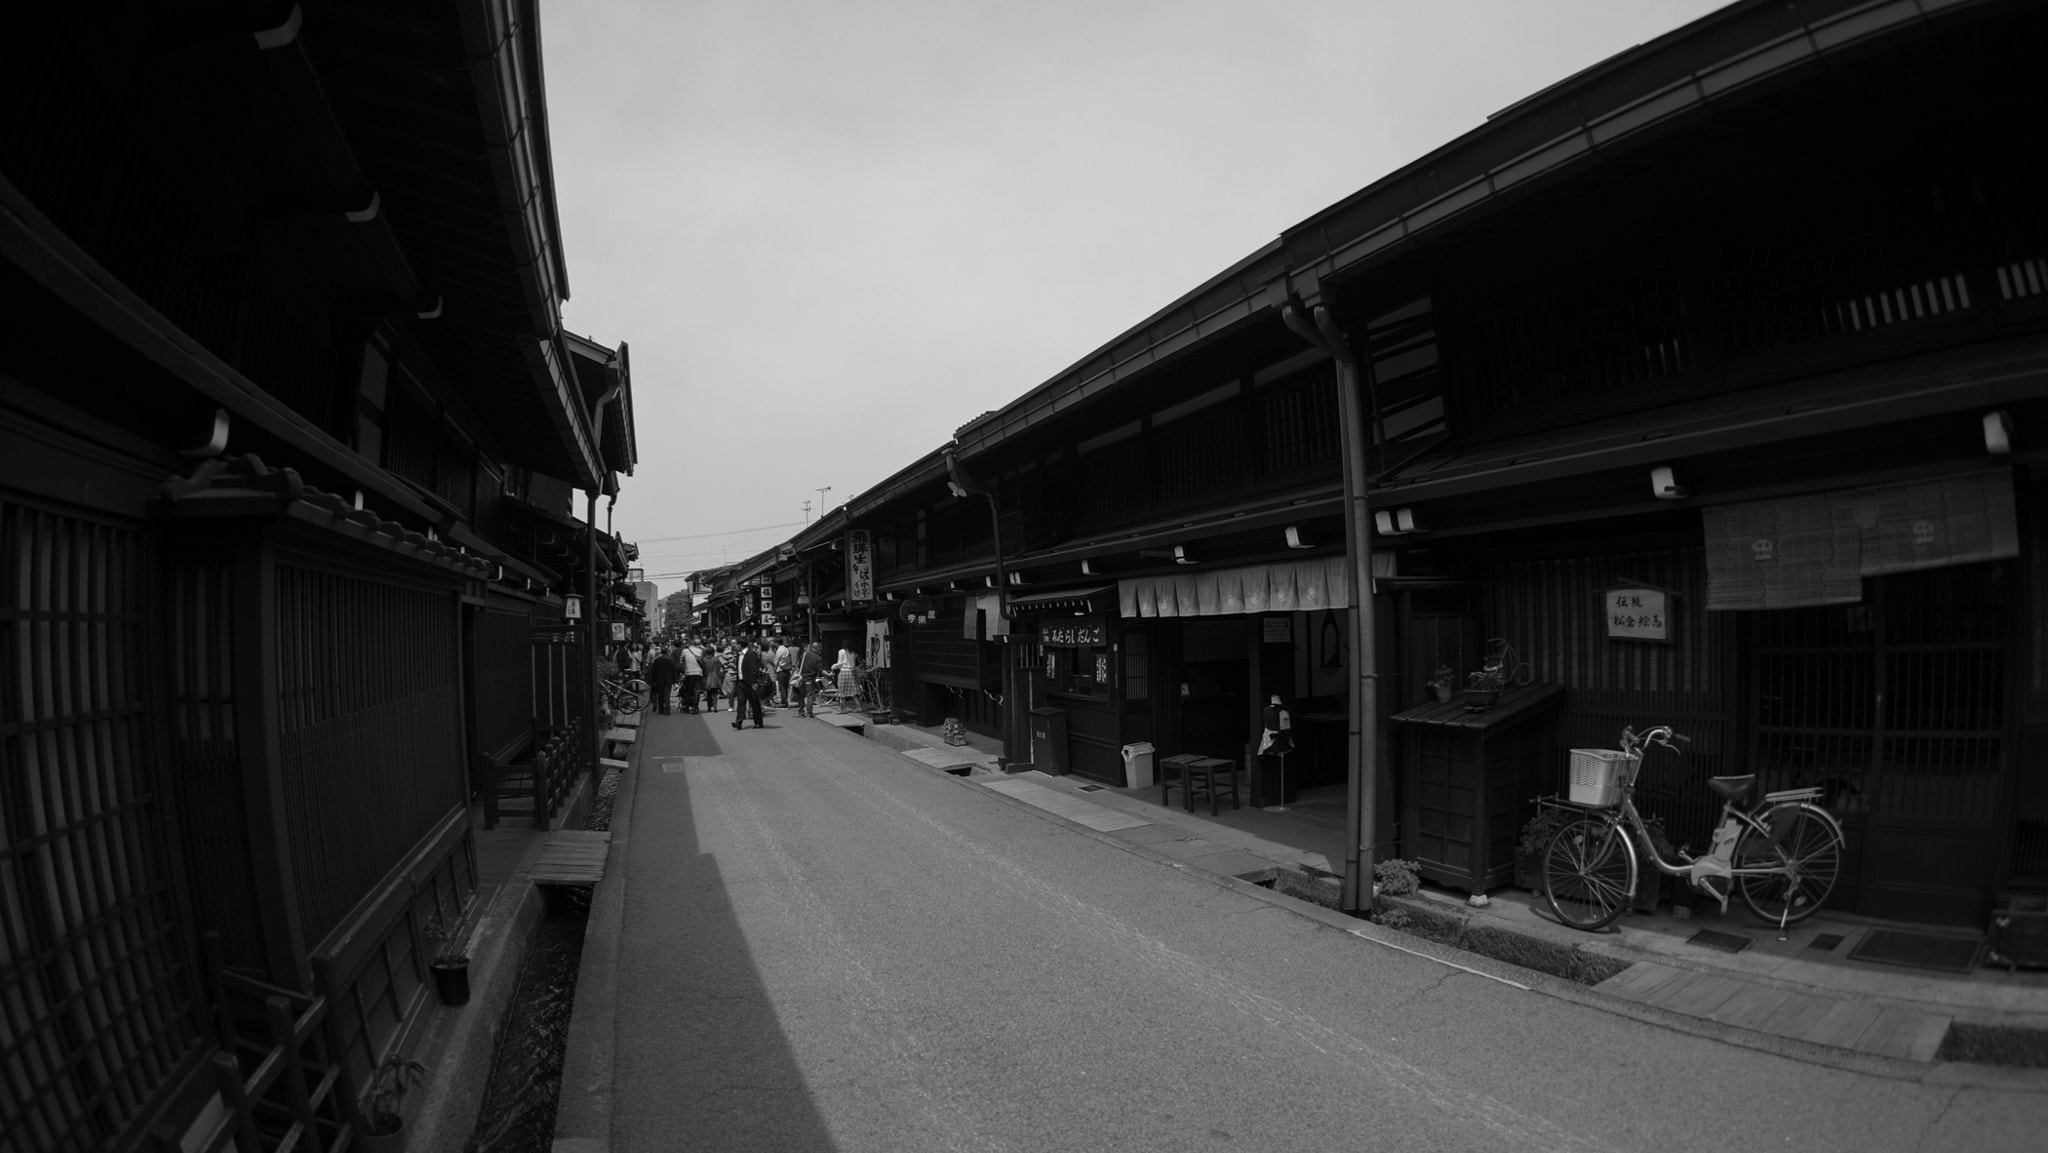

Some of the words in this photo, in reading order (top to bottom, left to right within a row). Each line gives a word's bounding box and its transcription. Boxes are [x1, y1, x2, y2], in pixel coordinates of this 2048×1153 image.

[1616, 596, 1643, 608] 伝統
[1613, 615, 1662, 628] 松倉絵馬
